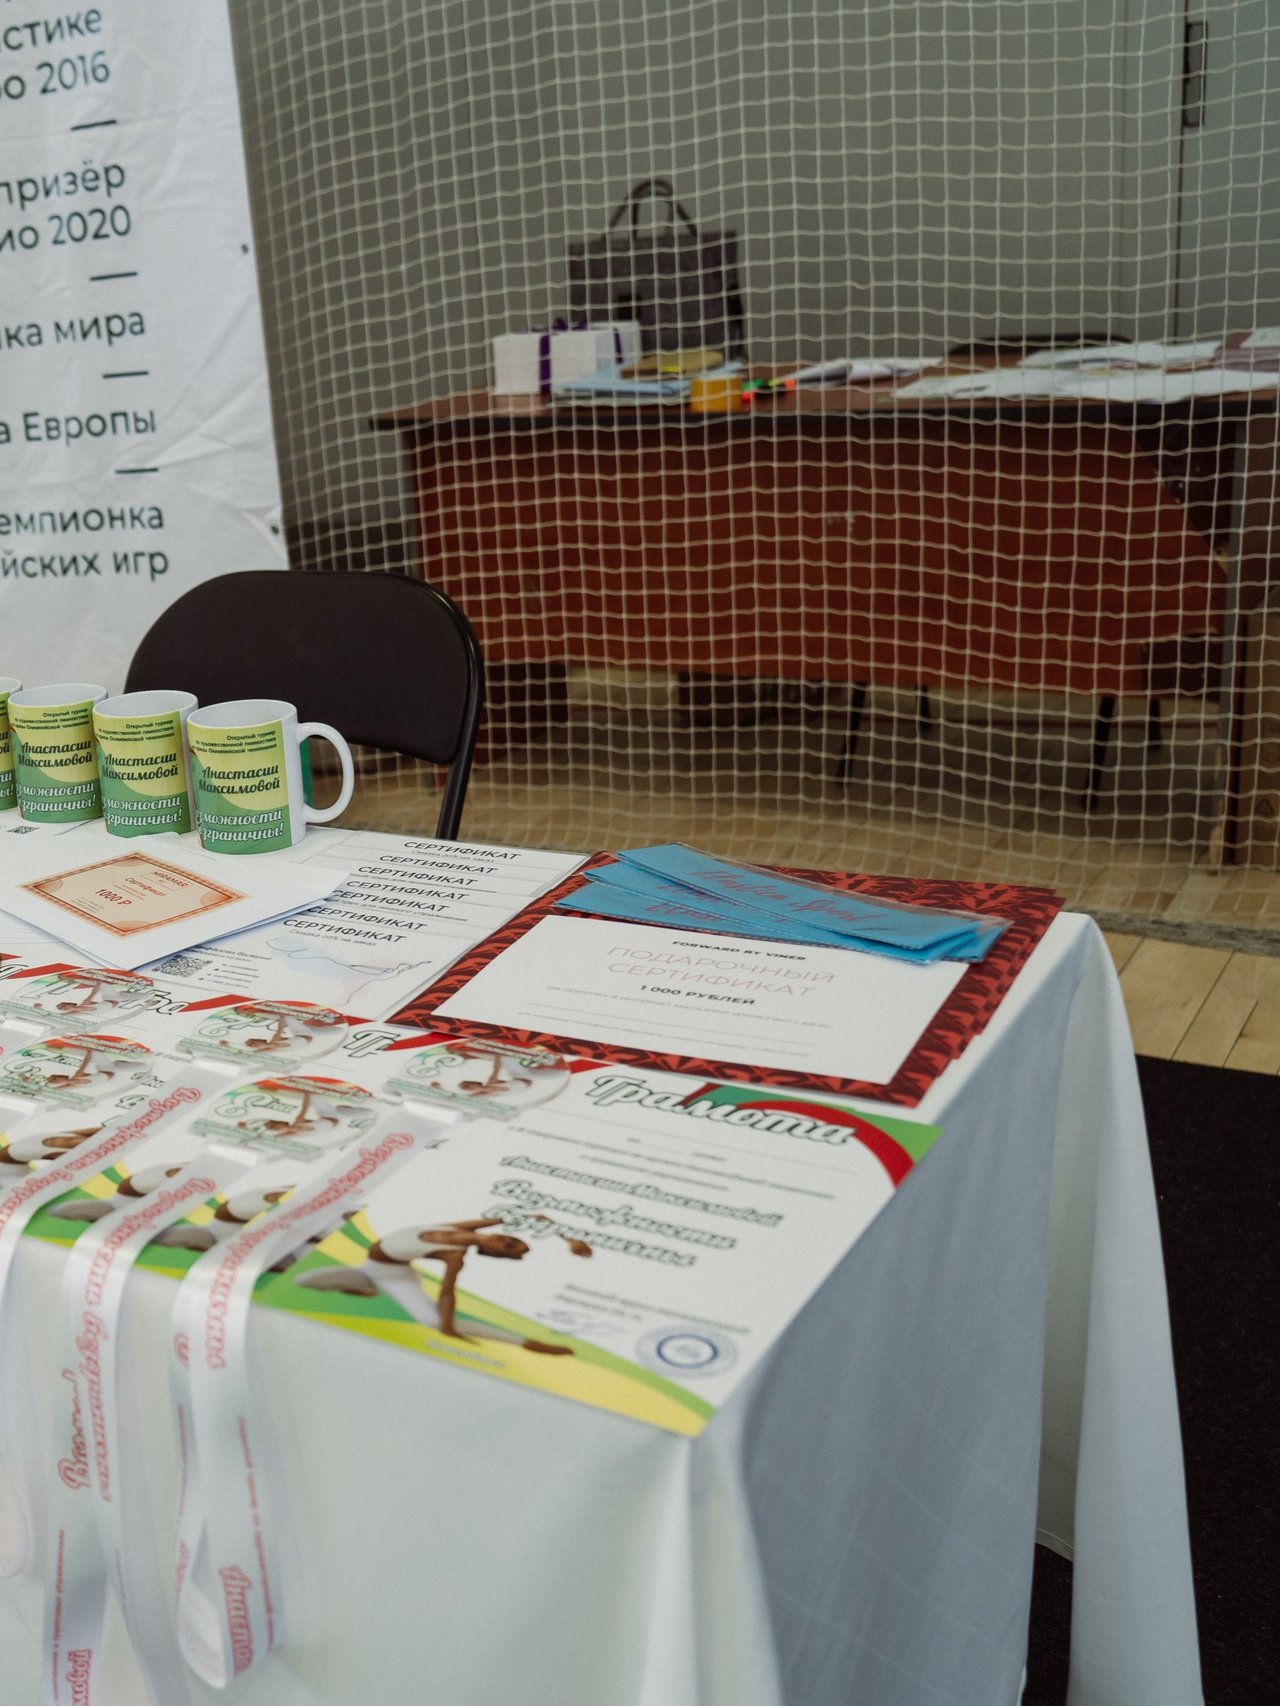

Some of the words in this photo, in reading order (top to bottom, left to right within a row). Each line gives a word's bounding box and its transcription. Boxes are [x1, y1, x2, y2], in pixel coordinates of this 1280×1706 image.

[38, 52, 111, 95] 2016
[50, 205, 132, 246] 2020
[54, 309, 147, 343] мира
[23, 408, 157, 444] Европы
[112, 548, 169, 580] игр
[20, 738, 92, 755] Анастасии
[17, 750, 93, 769] Максимовой
[104, 751, 178, 767] Анастасии
[101, 763, 179, 781] Максимовой
[202, 765, 279, 780] Анастасии
[198, 776, 281, 795] Максимовой
[404, 841, 522, 860] СЕРТИФИКАТ
[379, 855, 498, 874] СЕРТИФИКАТ
[358, 866, 478, 886] СЕРТИФИКАТ
[95, 889, 123, 903] 1000
[346, 880, 469, 901] СЕРТИФИКАТ
[283, 919, 408, 944] СЕРТИФИКАТ
[671, 940, 740, 954] FORWARD
[607, 946, 836, 983] ПОДАРОЧНЫЙ
[608, 963, 818, 997] СЕРТИФИКАТ
[650, 986, 682, 996] 000
[684, 991, 756, 1005] РУБЛЕЙ
[584, 1074, 859, 1145] Грамота
[65, 1087, 201, 1171] Возможности
